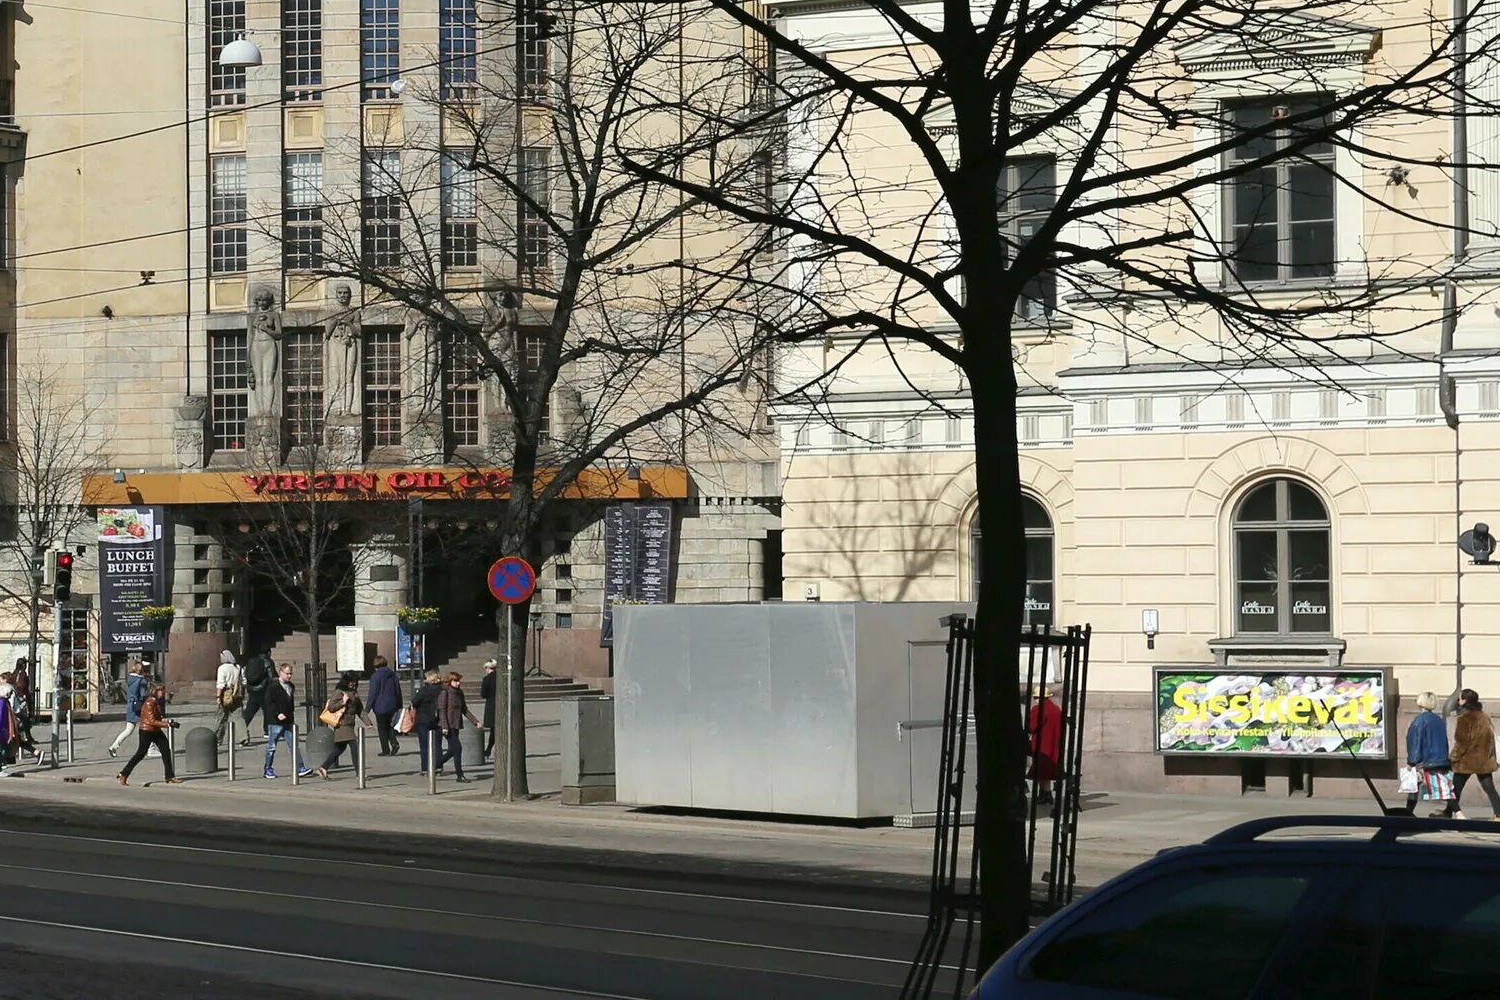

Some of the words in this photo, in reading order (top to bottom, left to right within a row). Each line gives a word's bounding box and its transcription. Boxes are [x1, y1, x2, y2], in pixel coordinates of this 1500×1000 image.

[243, 473, 376, 492] VIRGIN
[387, 471, 451, 490] OIL
[106, 550, 155, 561] LUNCH
[112, 634, 155, 642] VIRGIN
[1172, 686, 1380, 725] Sissikevät
